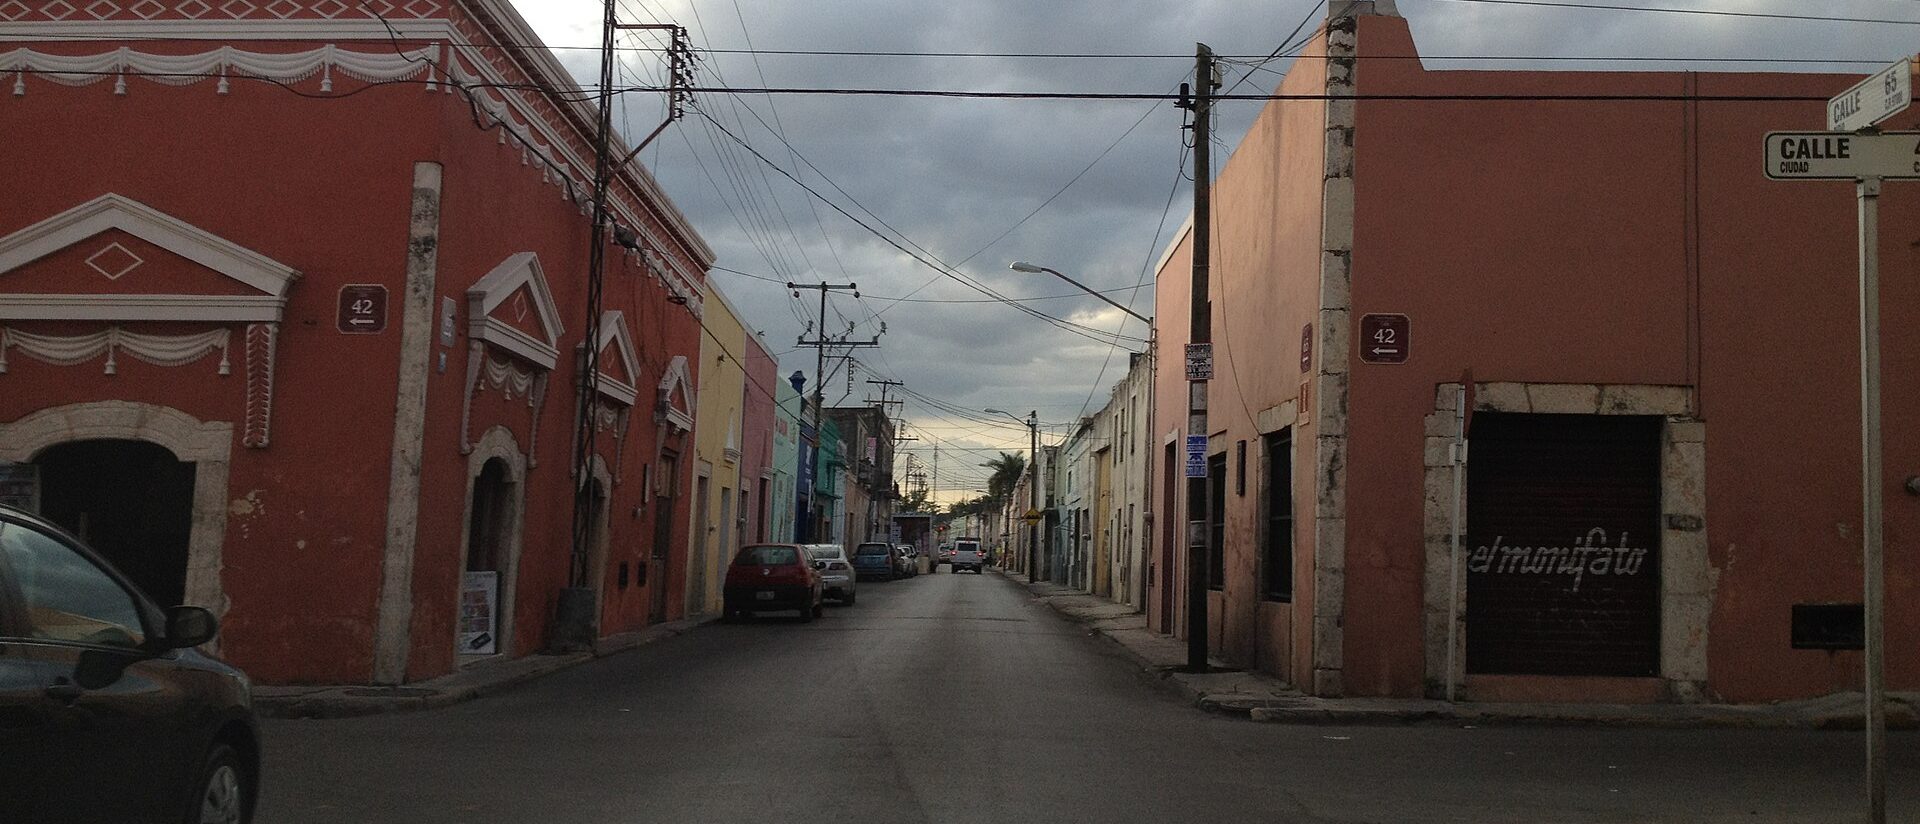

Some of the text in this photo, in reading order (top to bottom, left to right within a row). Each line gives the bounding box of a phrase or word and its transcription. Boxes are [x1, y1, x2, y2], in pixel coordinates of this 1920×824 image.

[1833, 91, 1861, 123] CALLE
[1884, 70, 1897, 95] 65
[1780, 138, 1850, 160] CALLE
[1780, 161, 1809, 173] CIUDAD
[351, 299, 373, 314] 42
[1374, 328, 1396, 344] 42
